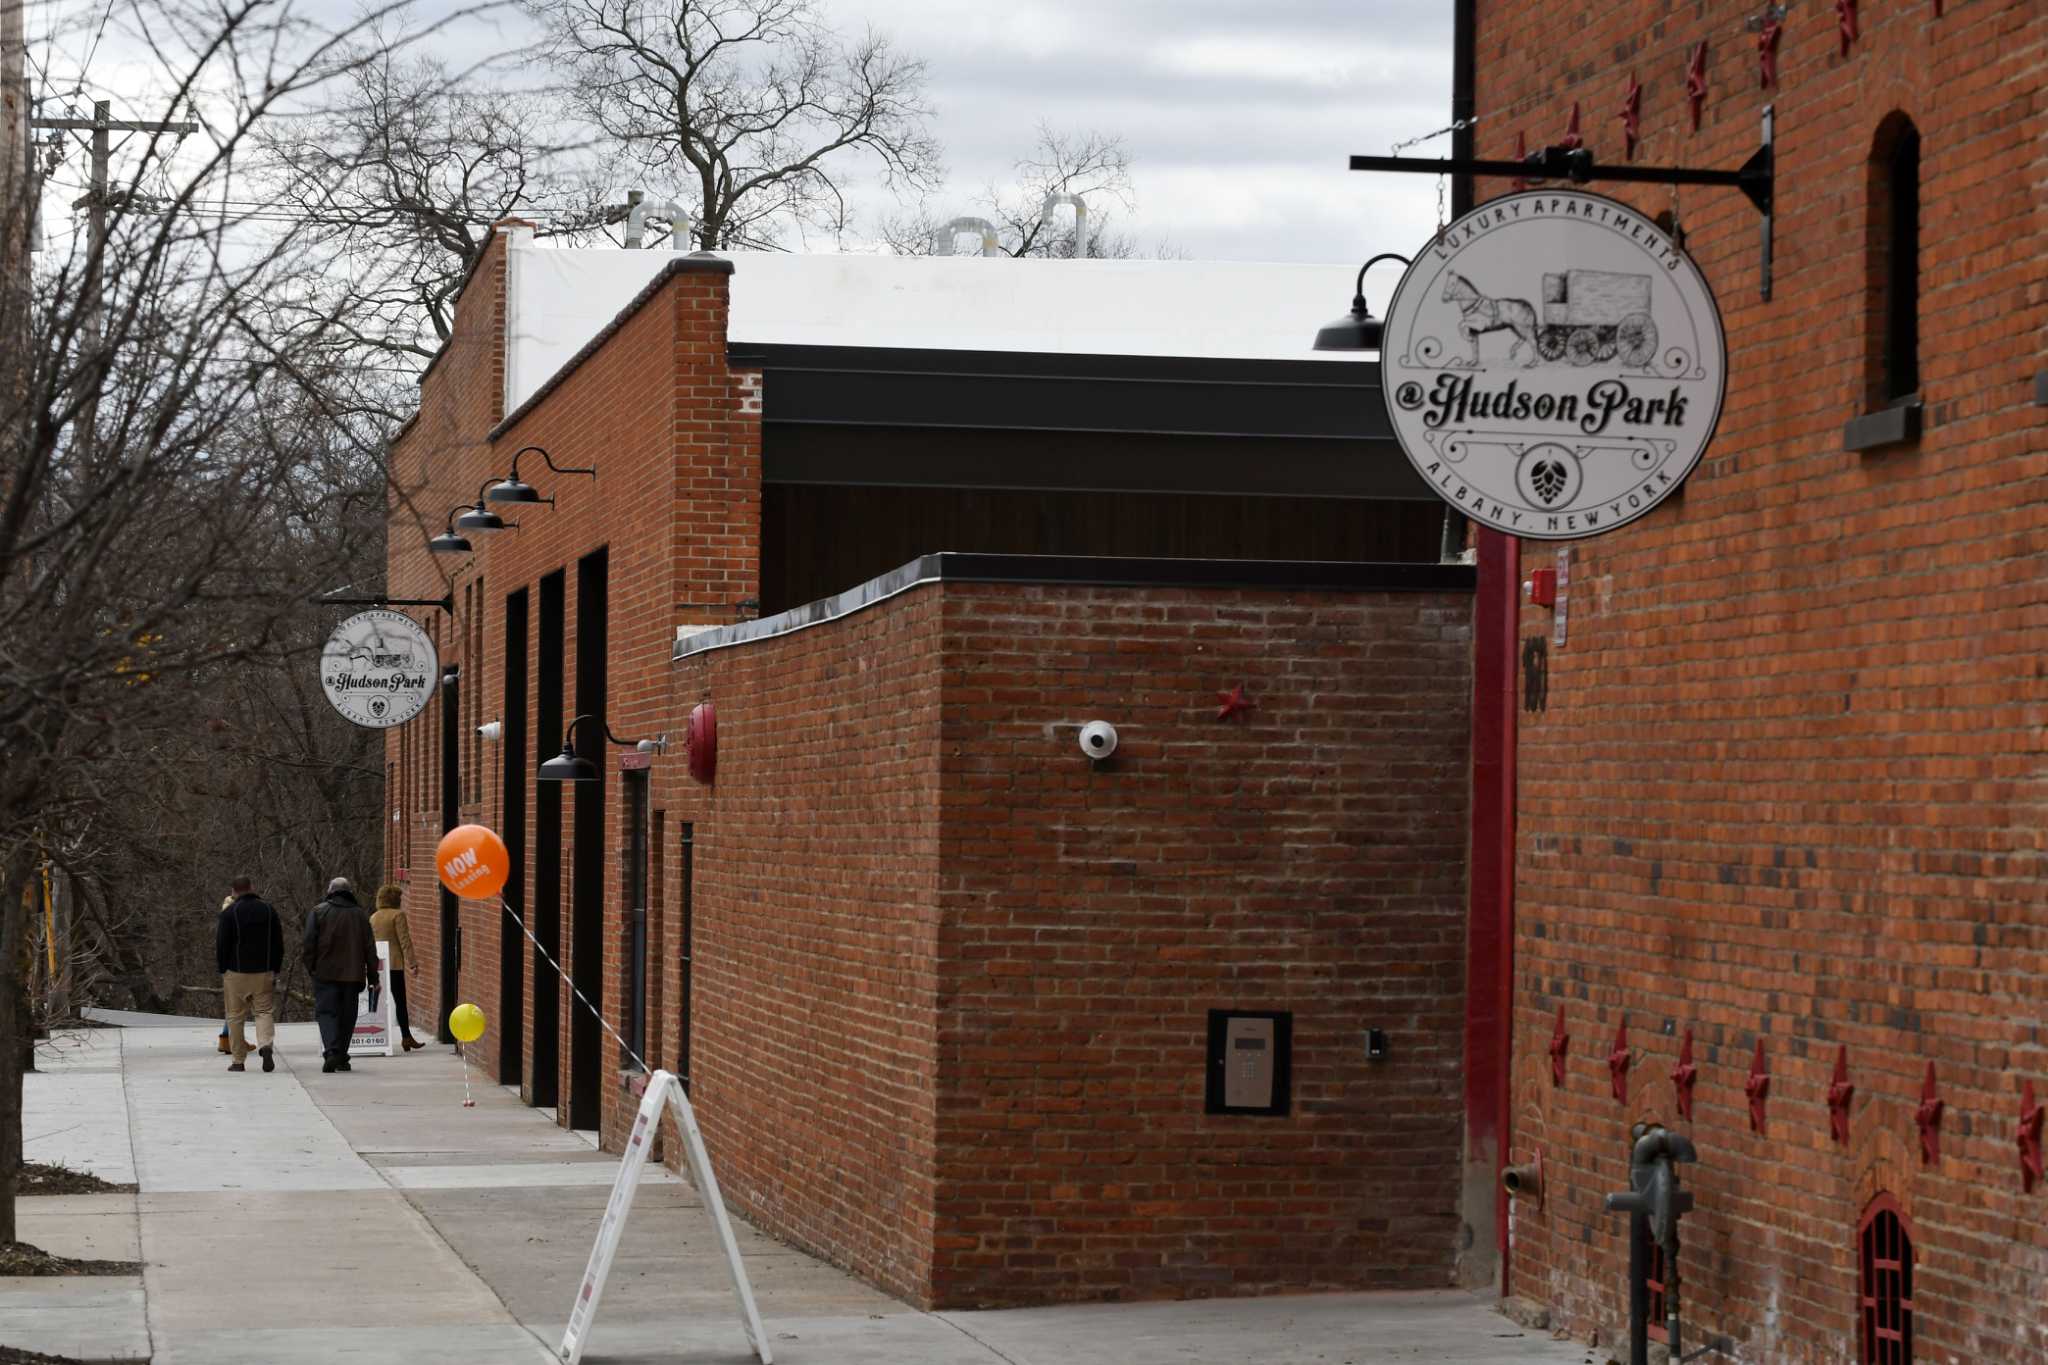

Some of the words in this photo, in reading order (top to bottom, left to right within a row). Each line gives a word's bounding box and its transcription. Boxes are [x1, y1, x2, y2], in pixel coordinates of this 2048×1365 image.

[1434, 203, 1521, 260] LUXURY
[1534, 199, 1682, 272] APARTMENTS
[1580, 380, 1689, 434] Park
[1548, 511, 1599, 530] NEW
[1609, 470, 1672, 518] YORK
[388, 673, 426, 692] Park
[443, 847, 477, 880] NOW
